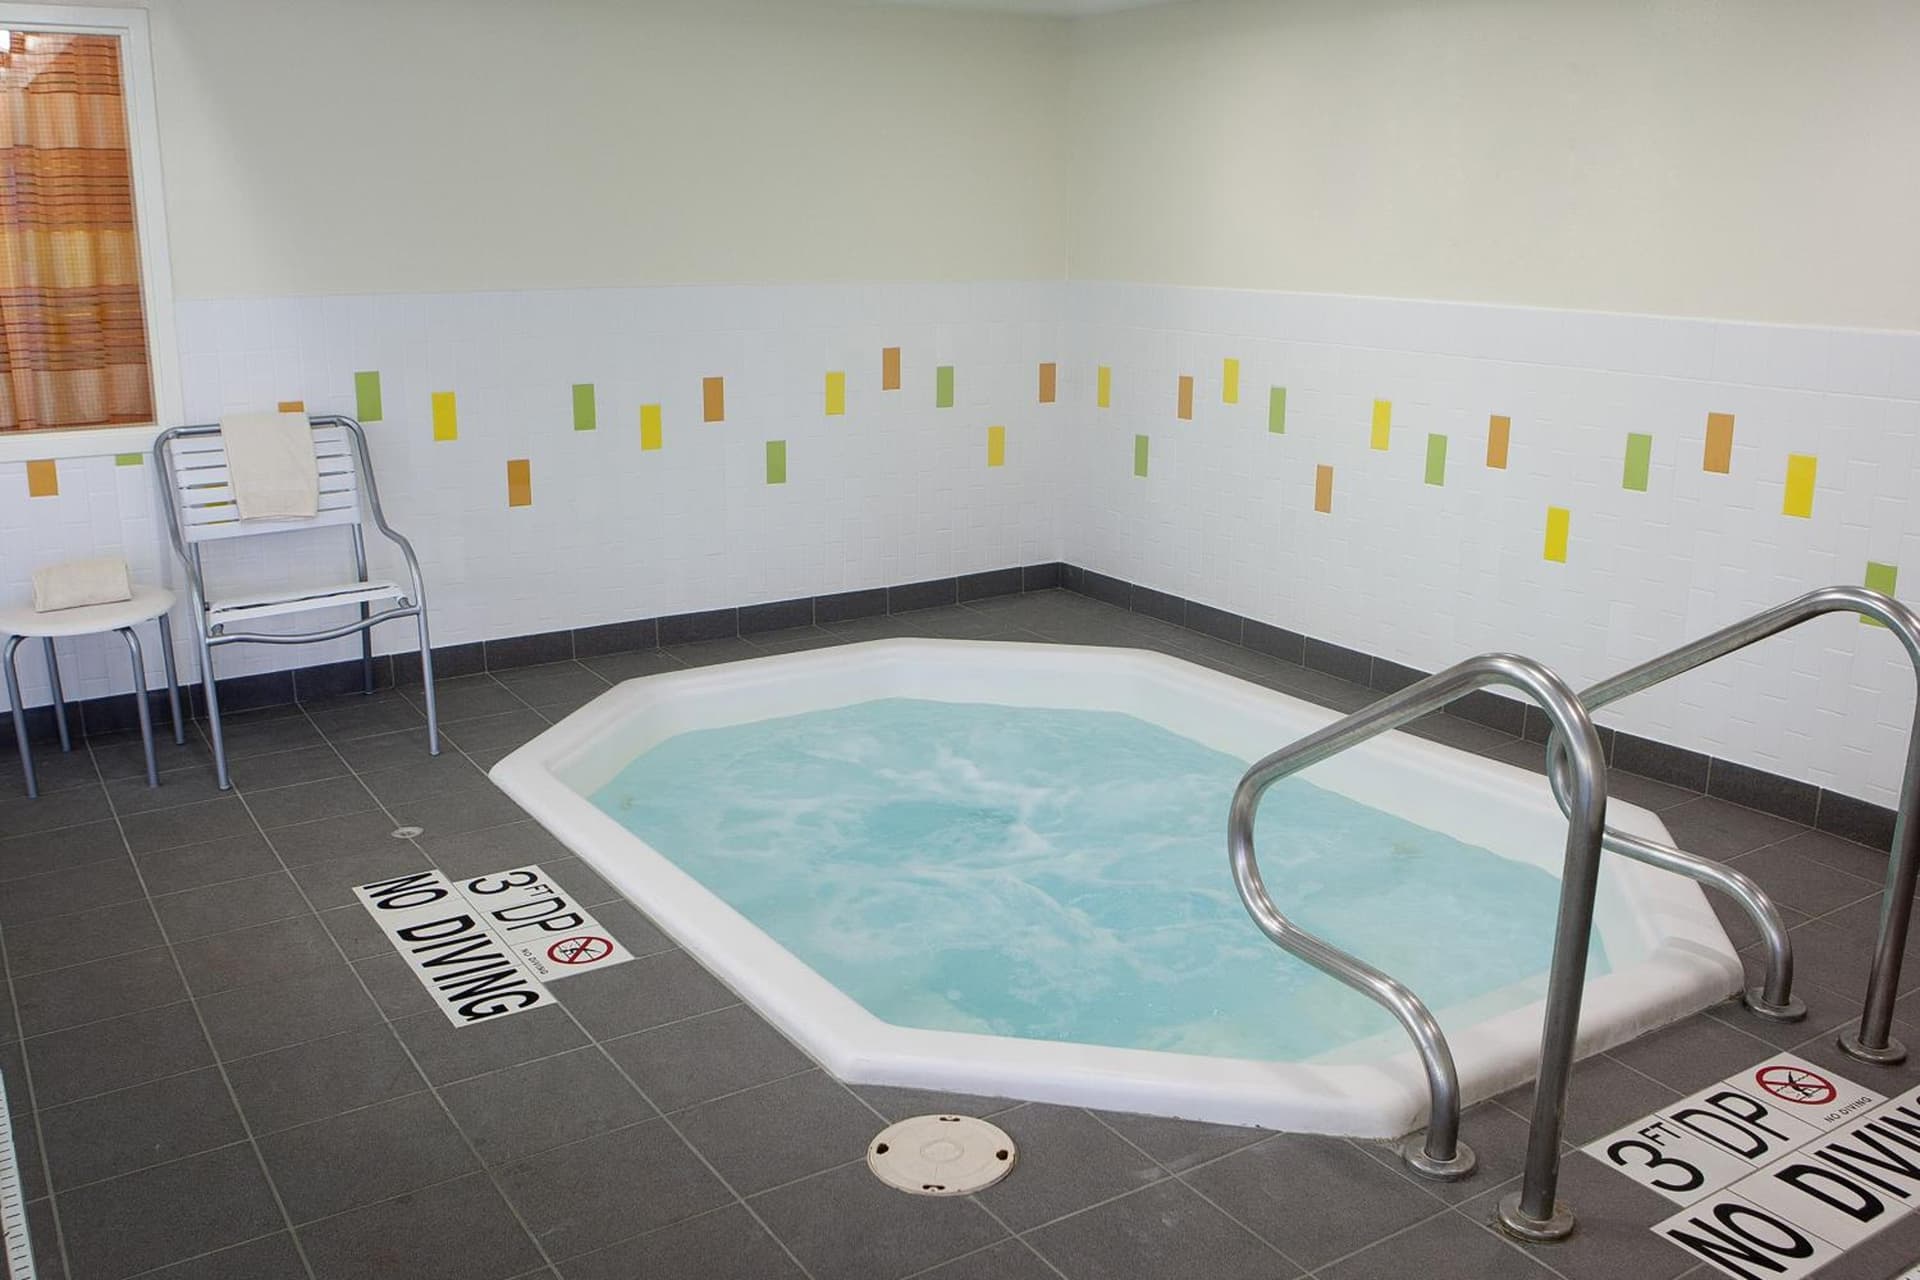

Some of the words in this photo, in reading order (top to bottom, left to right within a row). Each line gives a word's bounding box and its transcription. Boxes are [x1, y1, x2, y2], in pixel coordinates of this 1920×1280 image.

[363, 872, 449, 910] NO
[468, 871, 538, 895] 3
[491, 896, 584, 932] DP
[396, 914, 540, 1022] DIVING
[1824, 1113, 1841, 1123] NO
[1839, 1096, 1872, 1115] DIVING
[1607, 1139, 1704, 1192] 3
[1670, 1091, 1790, 1160] DP
[1667, 1203, 1814, 1280] NO
[1774, 1096, 1920, 1223] DIVI
